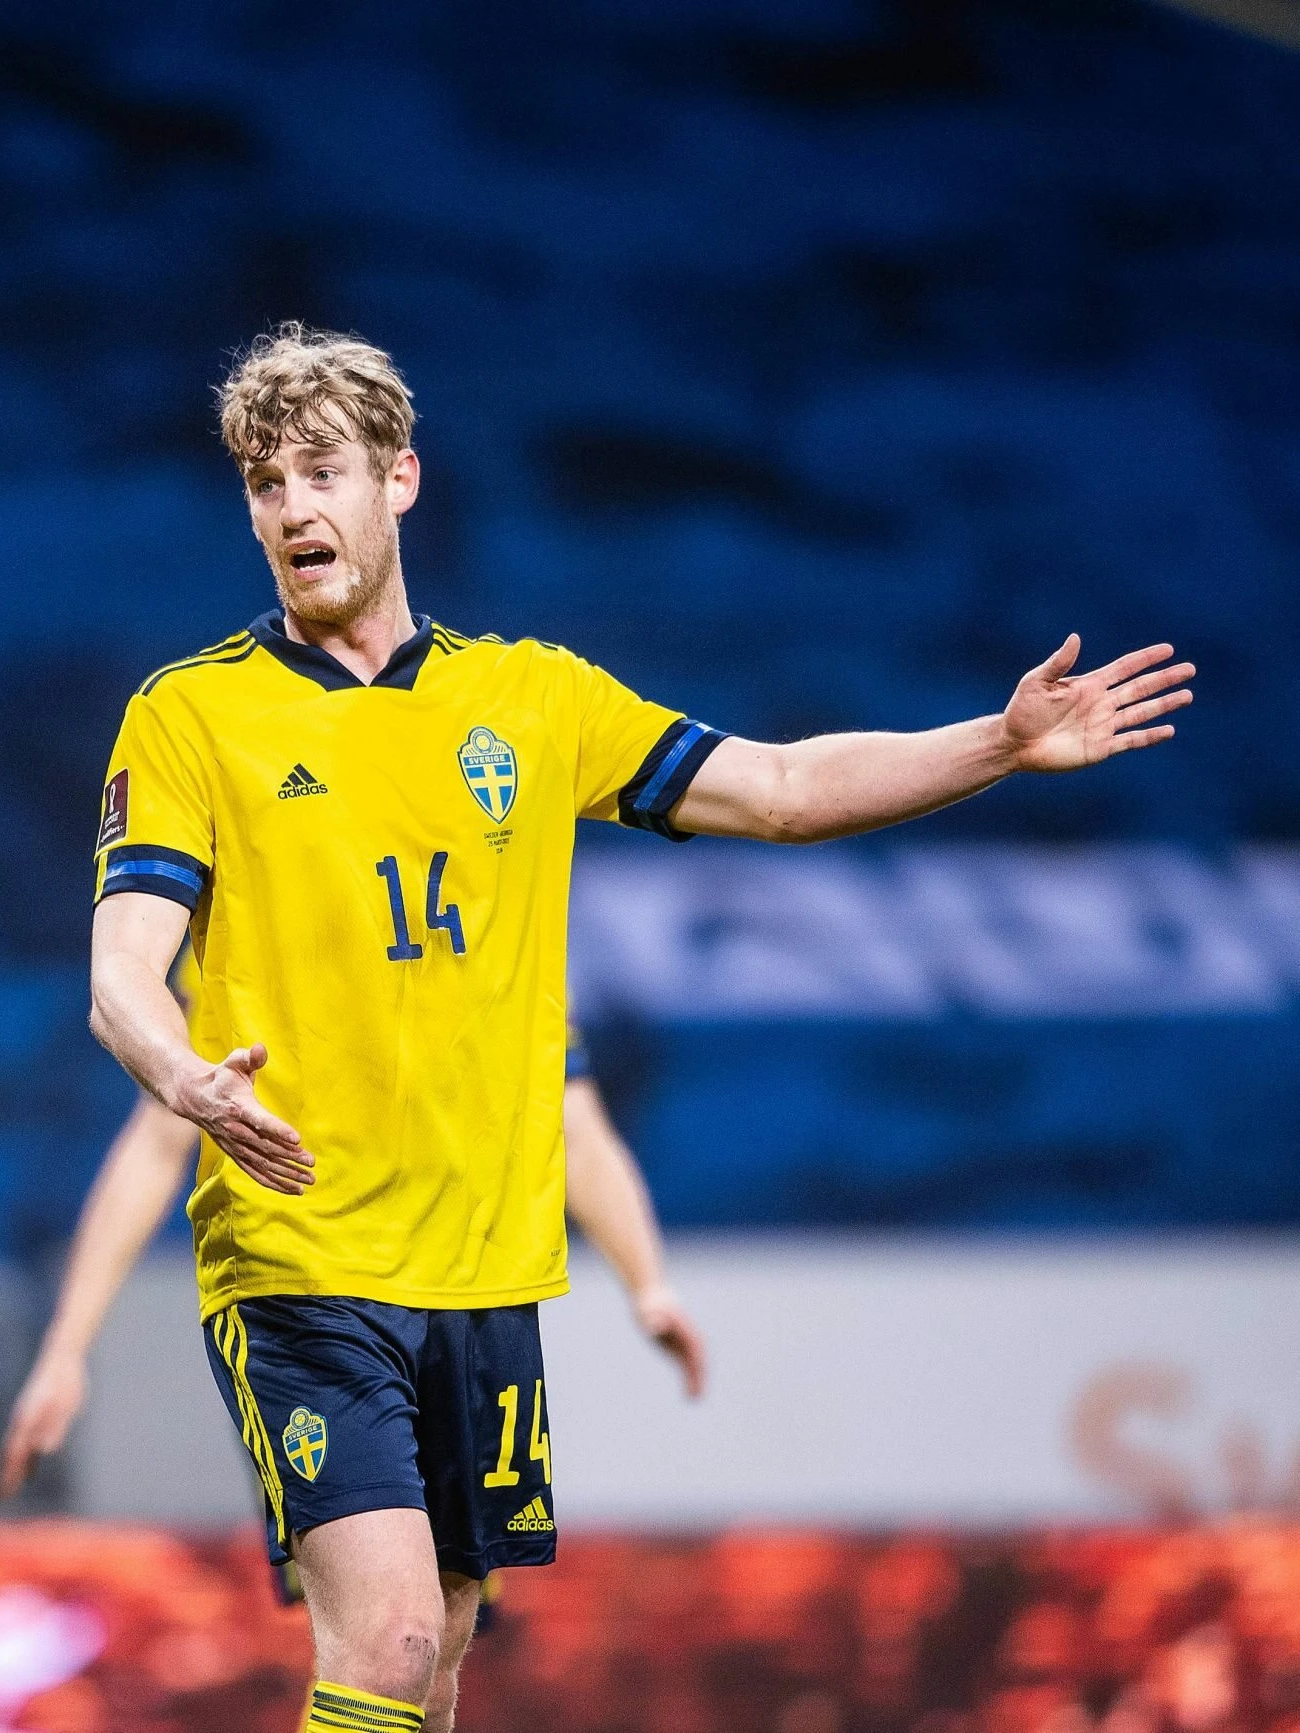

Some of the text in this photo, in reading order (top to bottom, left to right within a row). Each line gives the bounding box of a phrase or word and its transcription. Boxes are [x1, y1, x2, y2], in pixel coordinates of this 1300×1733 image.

[468, 754, 506, 765] SVERIGE
[277, 783, 329, 800] adidas
[376, 850, 467, 961] 14
[484, 1379, 552, 1489] 14
[507, 1518, 555, 1532] adidas
